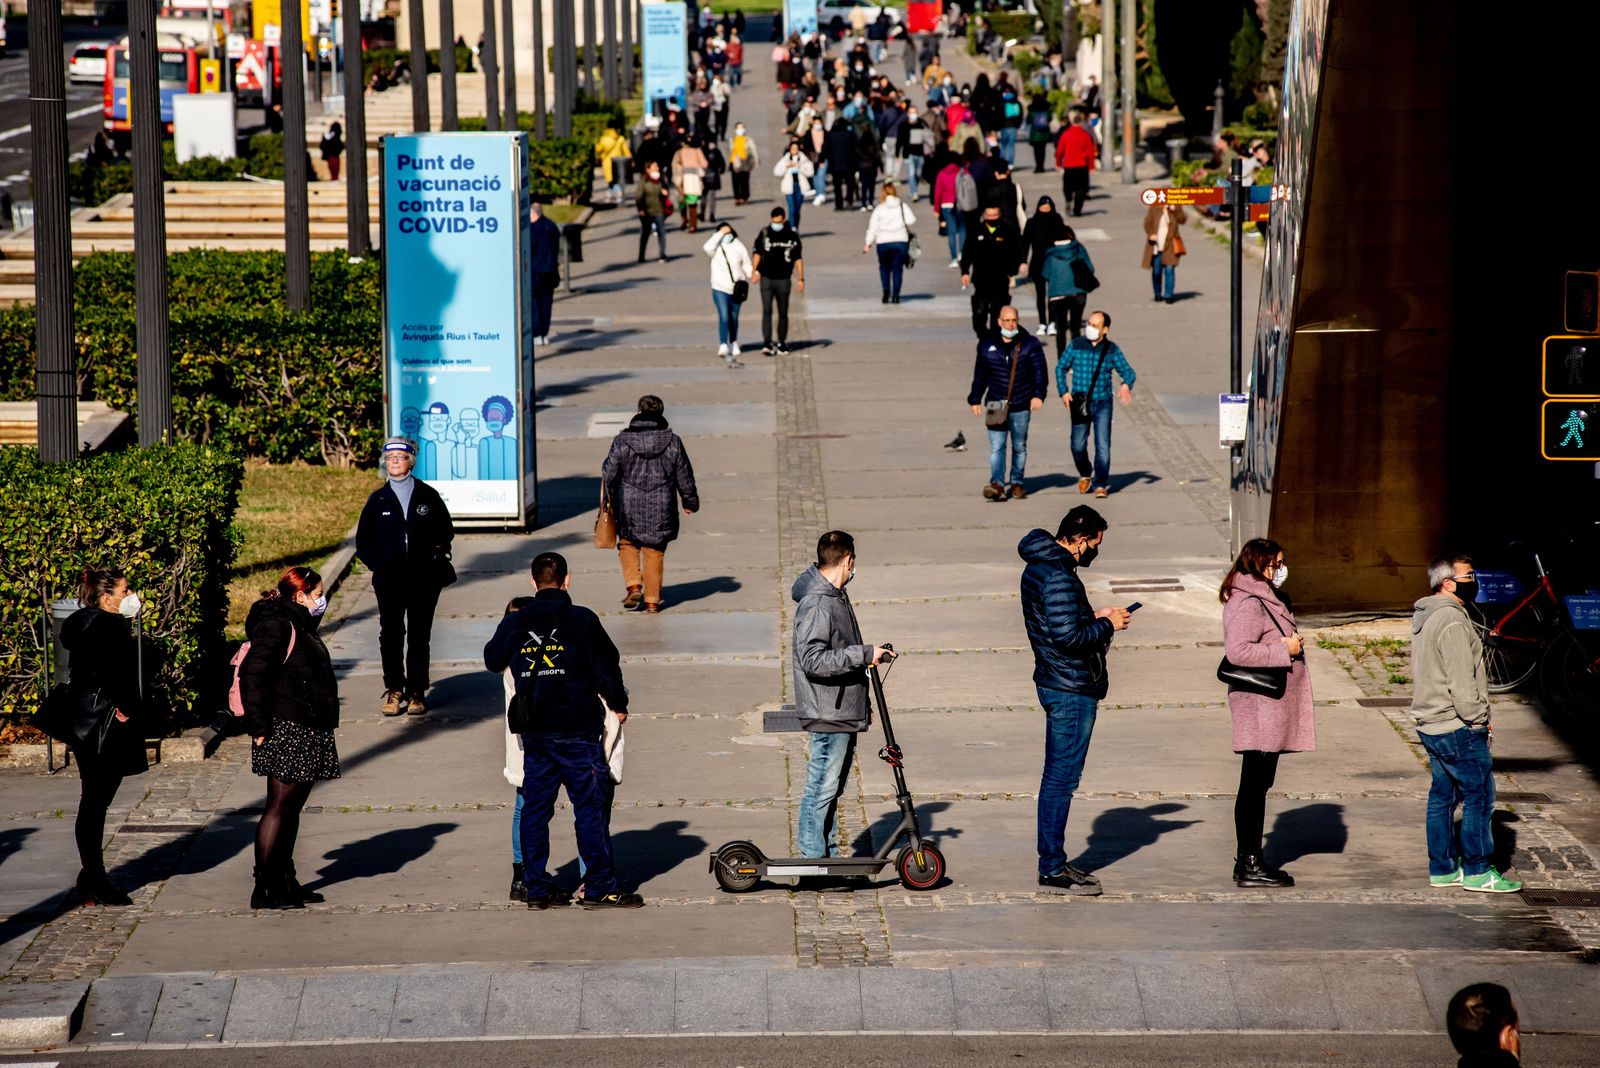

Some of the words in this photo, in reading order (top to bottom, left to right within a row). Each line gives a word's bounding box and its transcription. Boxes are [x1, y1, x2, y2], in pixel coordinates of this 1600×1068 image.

[397, 154, 444, 170] Punt
[450, 154, 475, 170] de
[397, 175, 502, 191] vacunació
[398, 197, 464, 212] contra
[470, 196, 487, 212] la
[398, 217, 499, 234] COVID-19
[429, 324, 444, 332] per
[402, 332, 444, 342] Avinguda
[446, 332, 466, 340] Rius
[468, 332, 471, 340] i
[472, 332, 500, 340] Taulet
